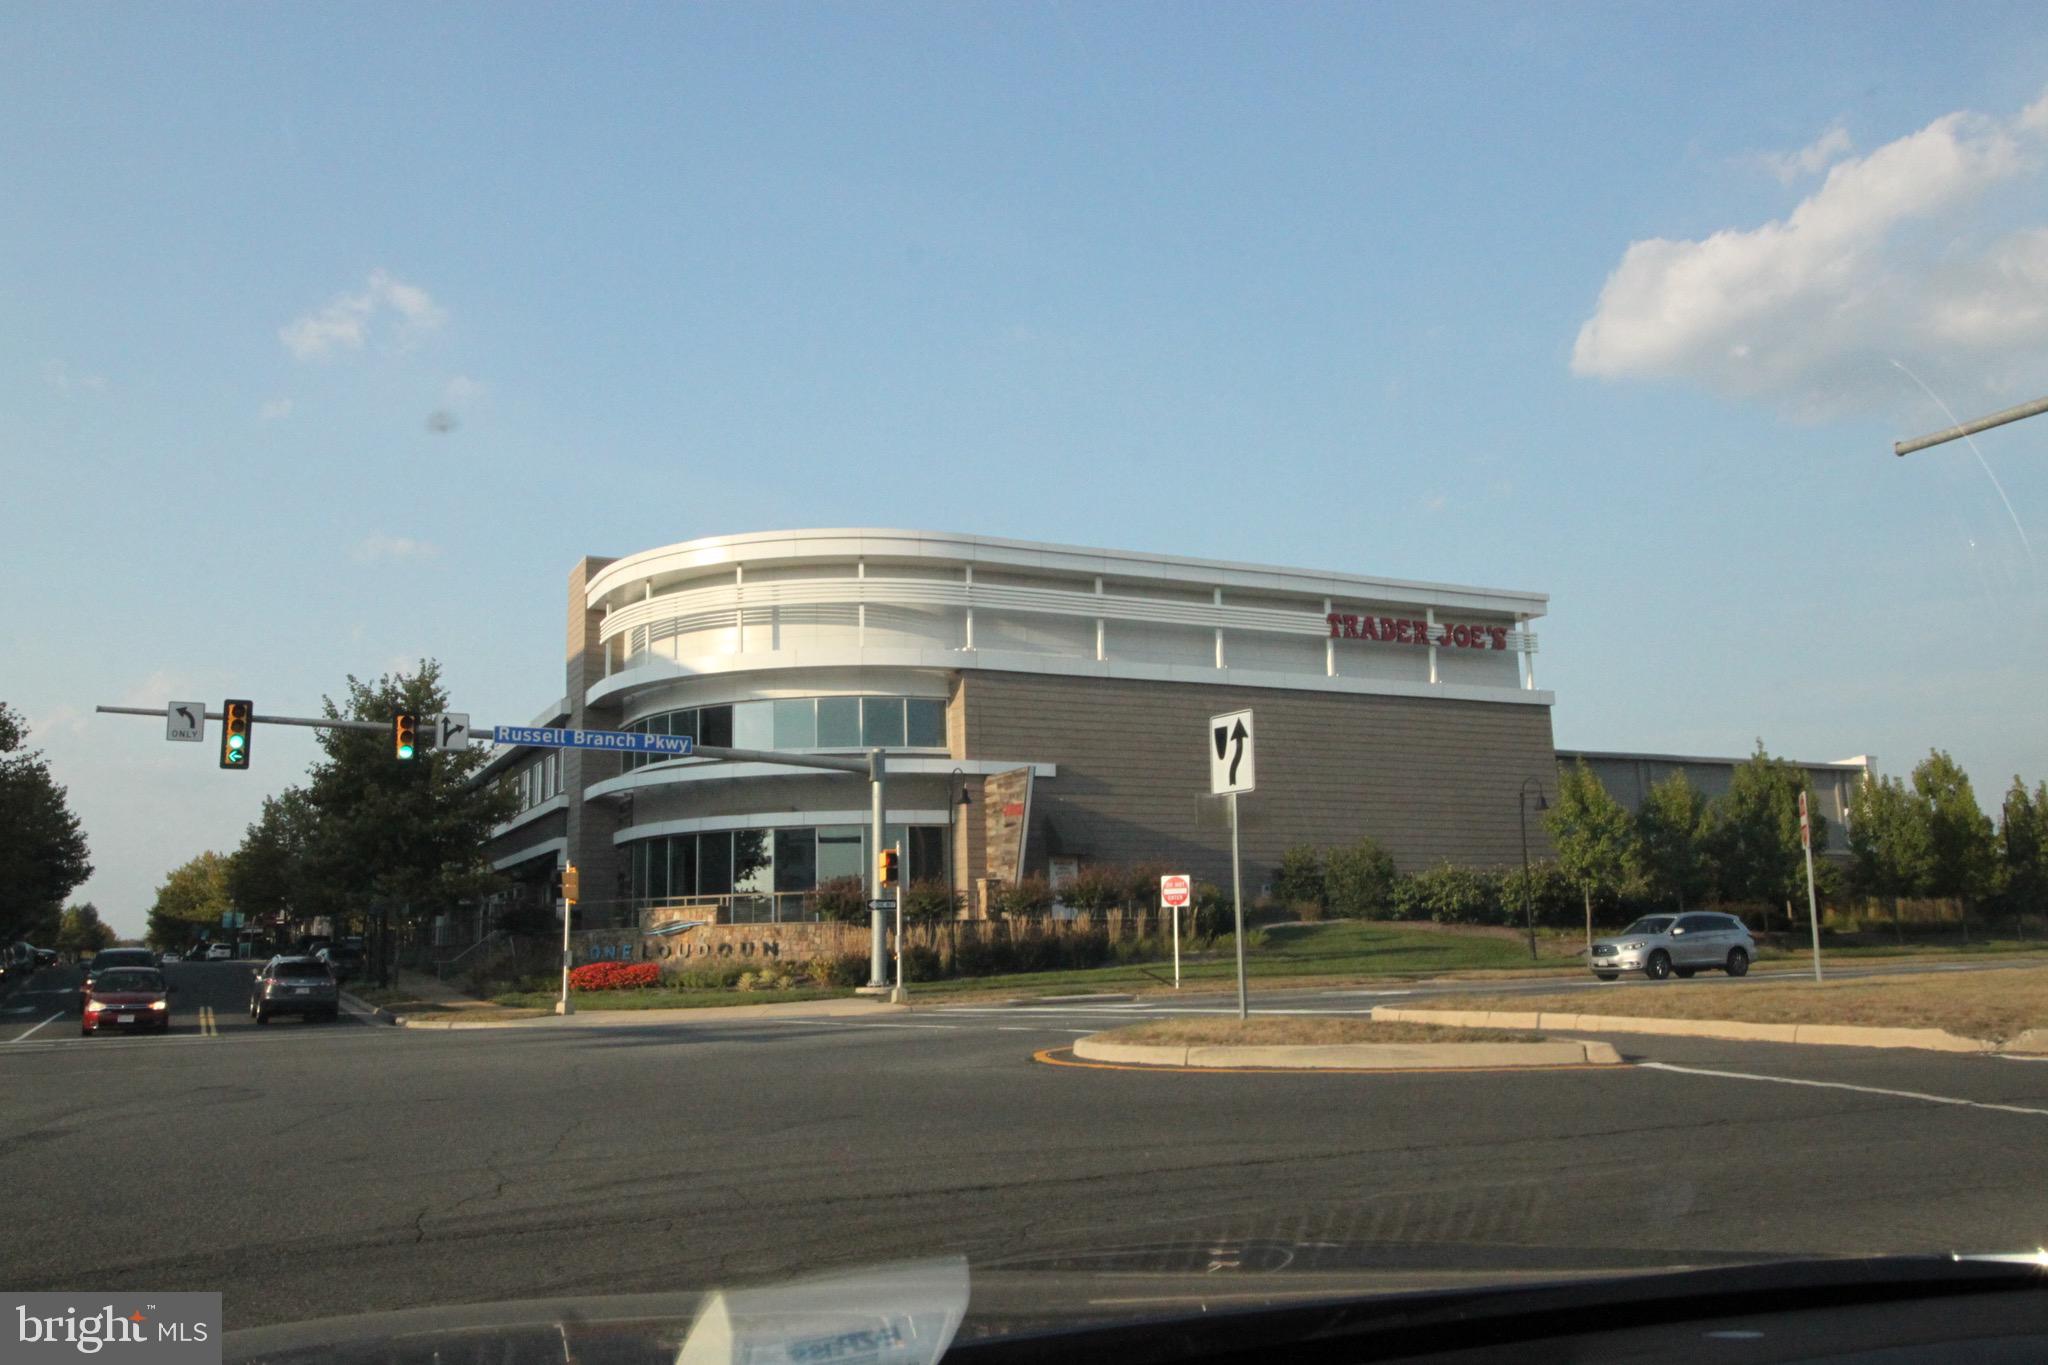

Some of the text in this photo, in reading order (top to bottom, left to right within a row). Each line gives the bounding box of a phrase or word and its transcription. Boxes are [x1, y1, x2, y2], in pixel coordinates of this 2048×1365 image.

[1327, 613, 1507, 650] TRADER JOE'S
[172, 729, 198, 738] ONLY
[499, 728, 689, 753] Russell Branch Pkwy
[642, 940, 780, 960] LOUDOUN
